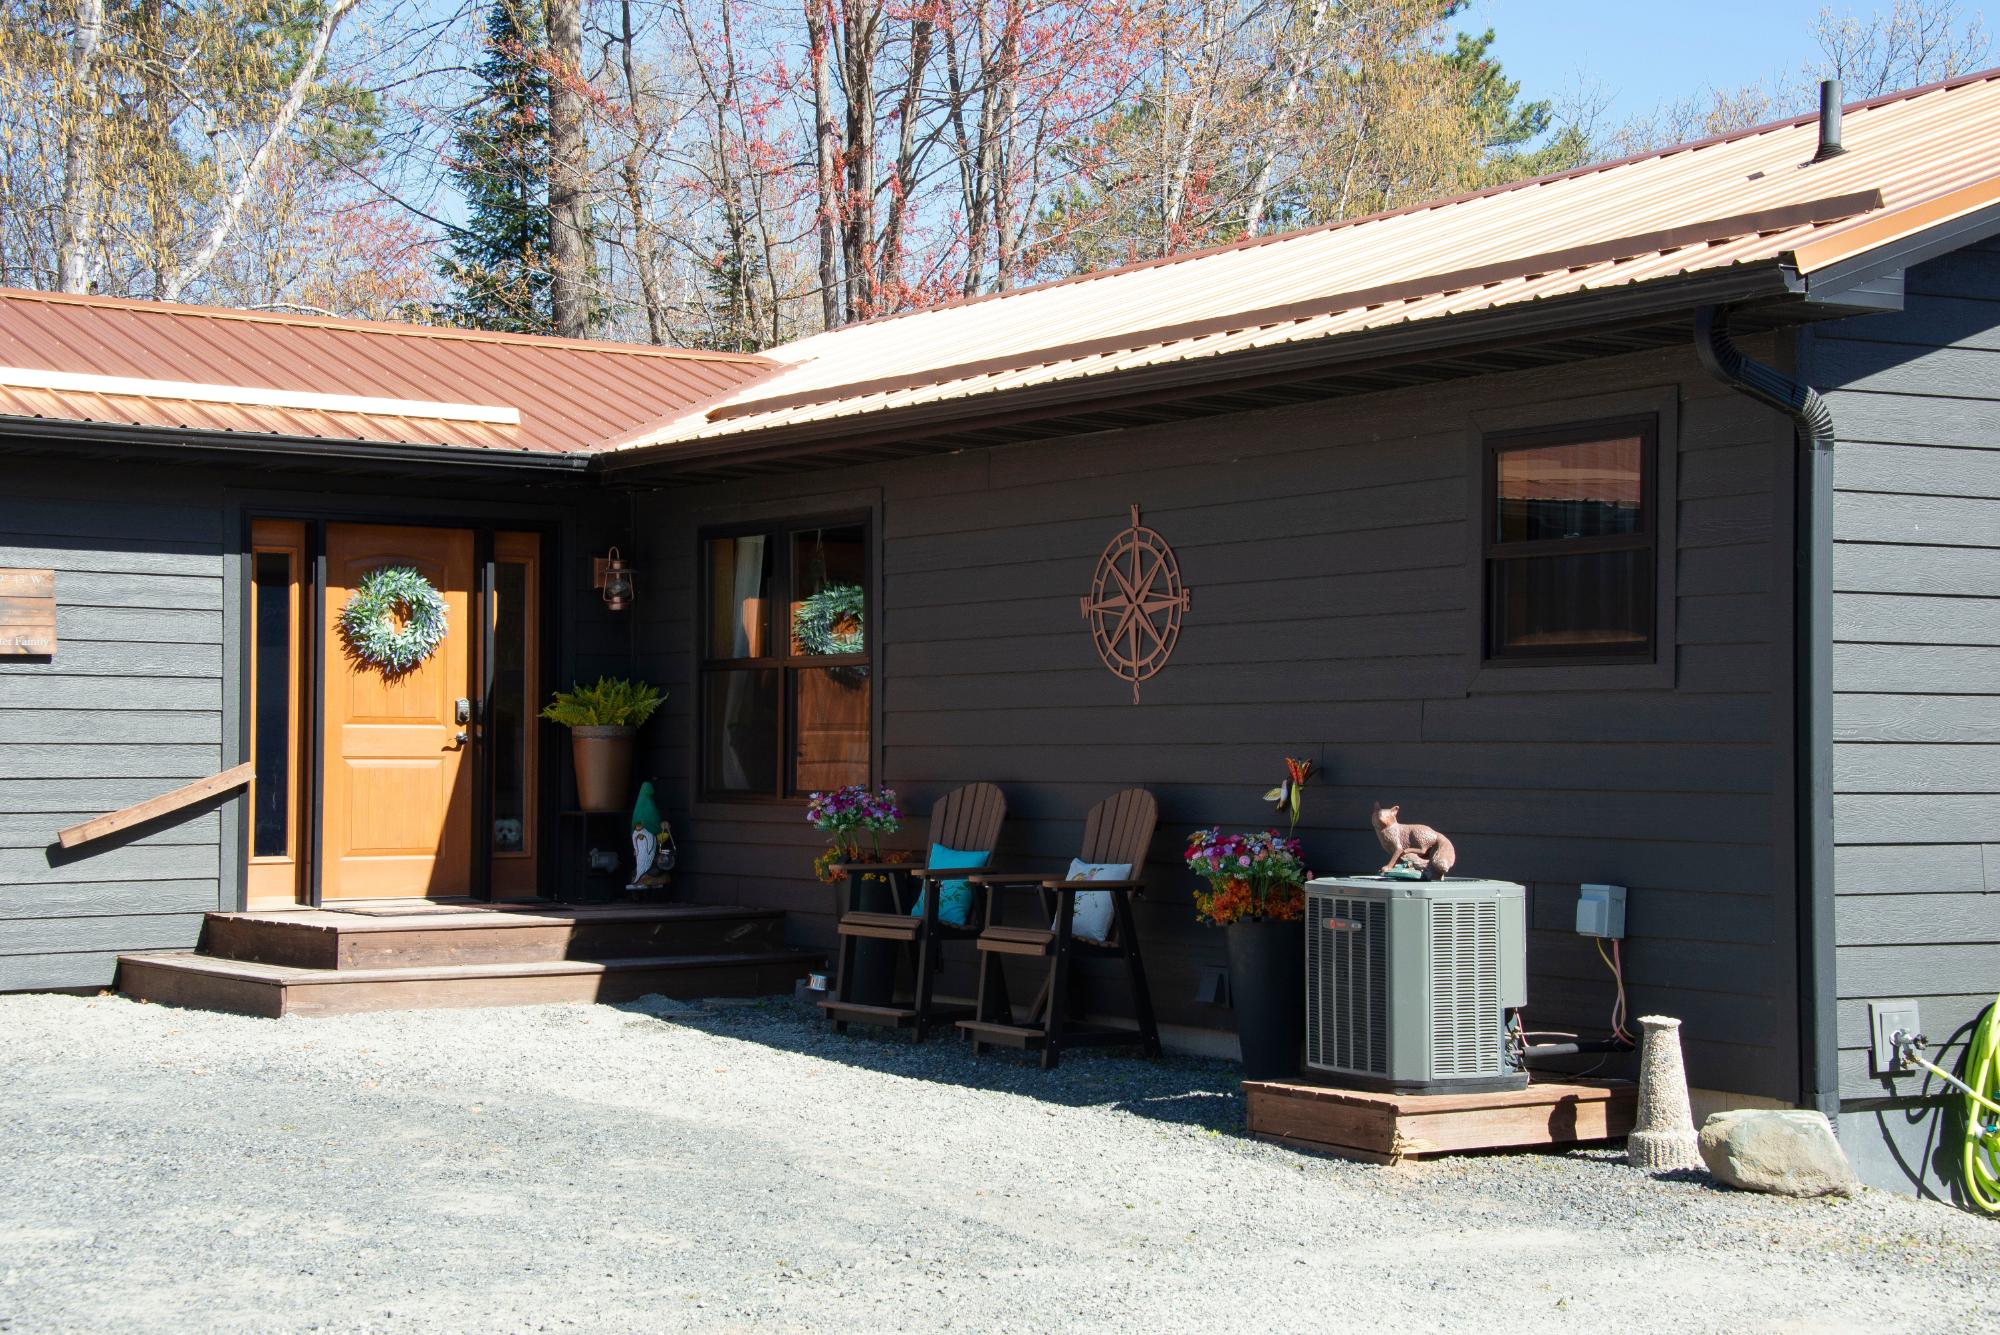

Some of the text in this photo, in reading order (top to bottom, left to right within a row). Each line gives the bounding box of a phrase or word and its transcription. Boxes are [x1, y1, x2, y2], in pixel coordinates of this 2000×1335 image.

[1131, 504, 1139, 527] N
[31, 575, 42, 585] W
[1080, 596, 1091, 619] W
[1182, 588, 1190, 612] E
[15, 635, 49, 648] Family
[1134, 681, 1140, 704] S
